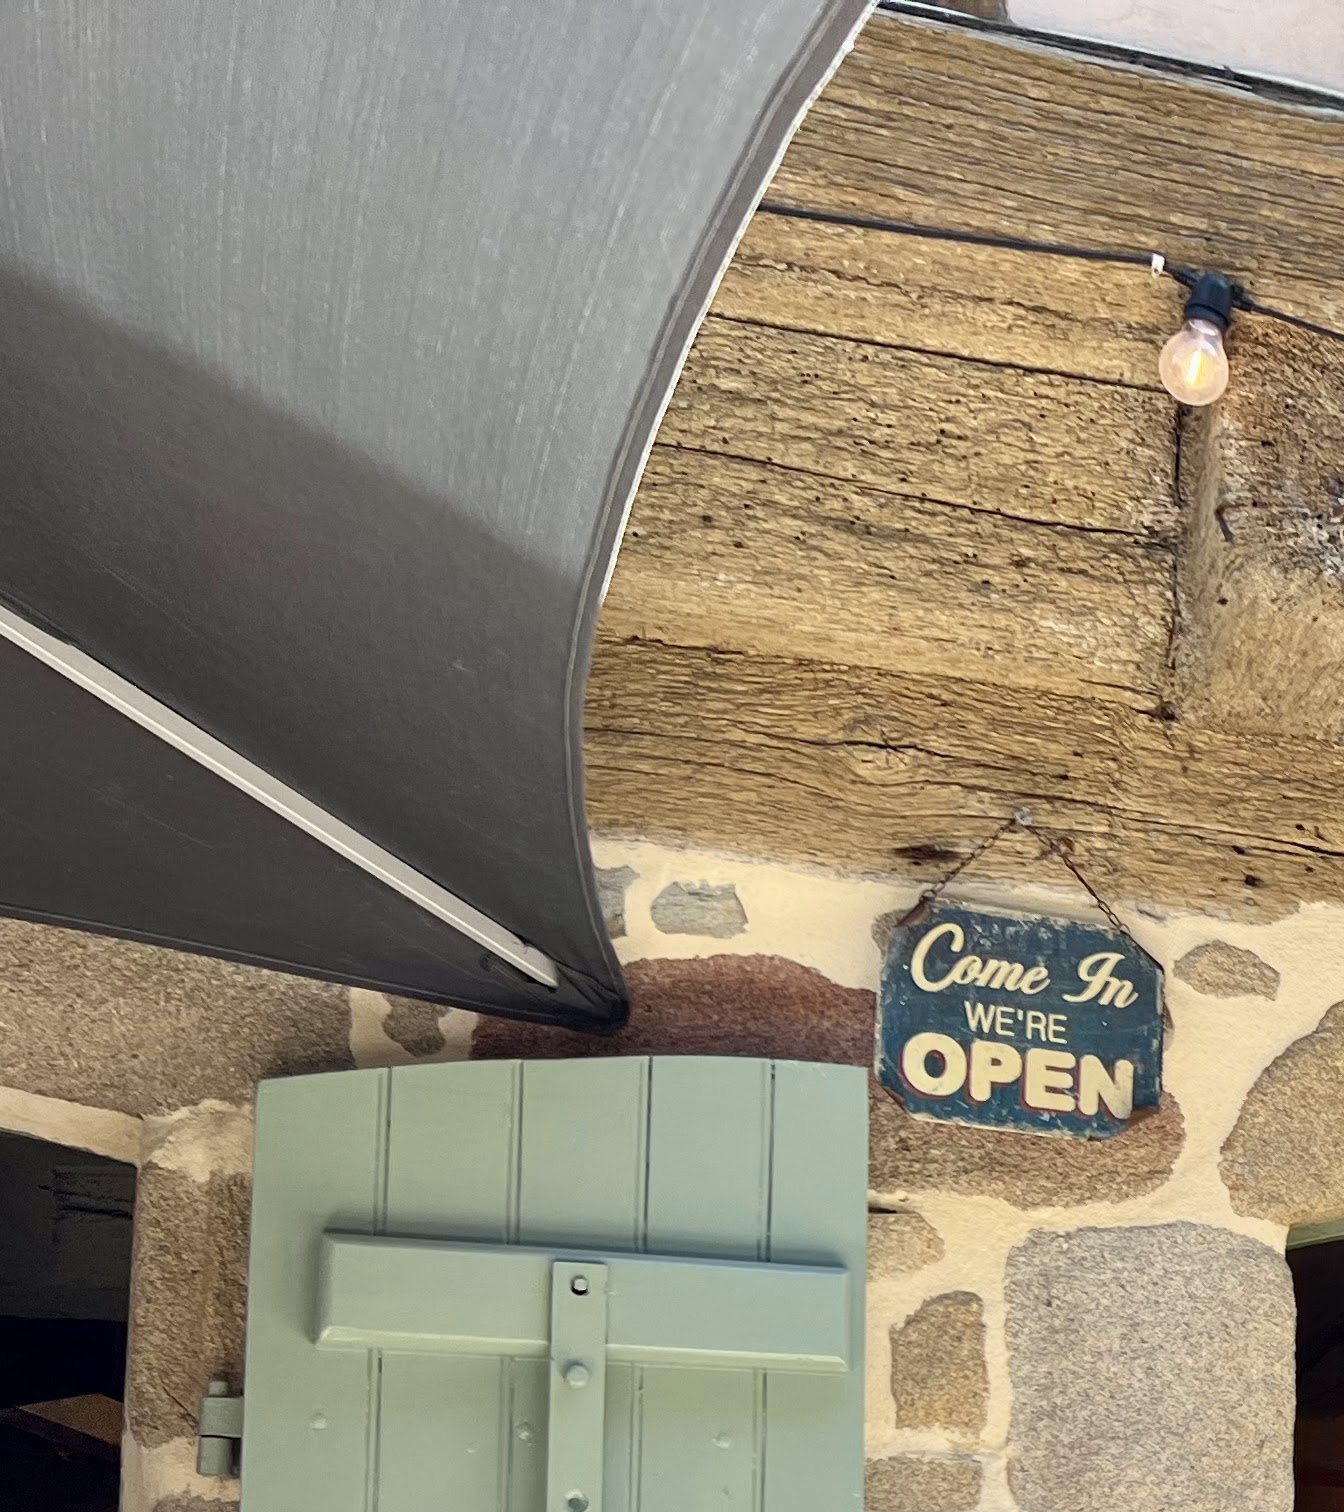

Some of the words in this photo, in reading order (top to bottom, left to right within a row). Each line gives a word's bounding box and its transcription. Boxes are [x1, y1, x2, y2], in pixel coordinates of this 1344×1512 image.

[910, 922, 1051, 994] Come
[1062, 951, 1139, 1009] In
[963, 1000, 1068, 1044] WE'RE
[901, 1031, 1135, 1120] OPEN
